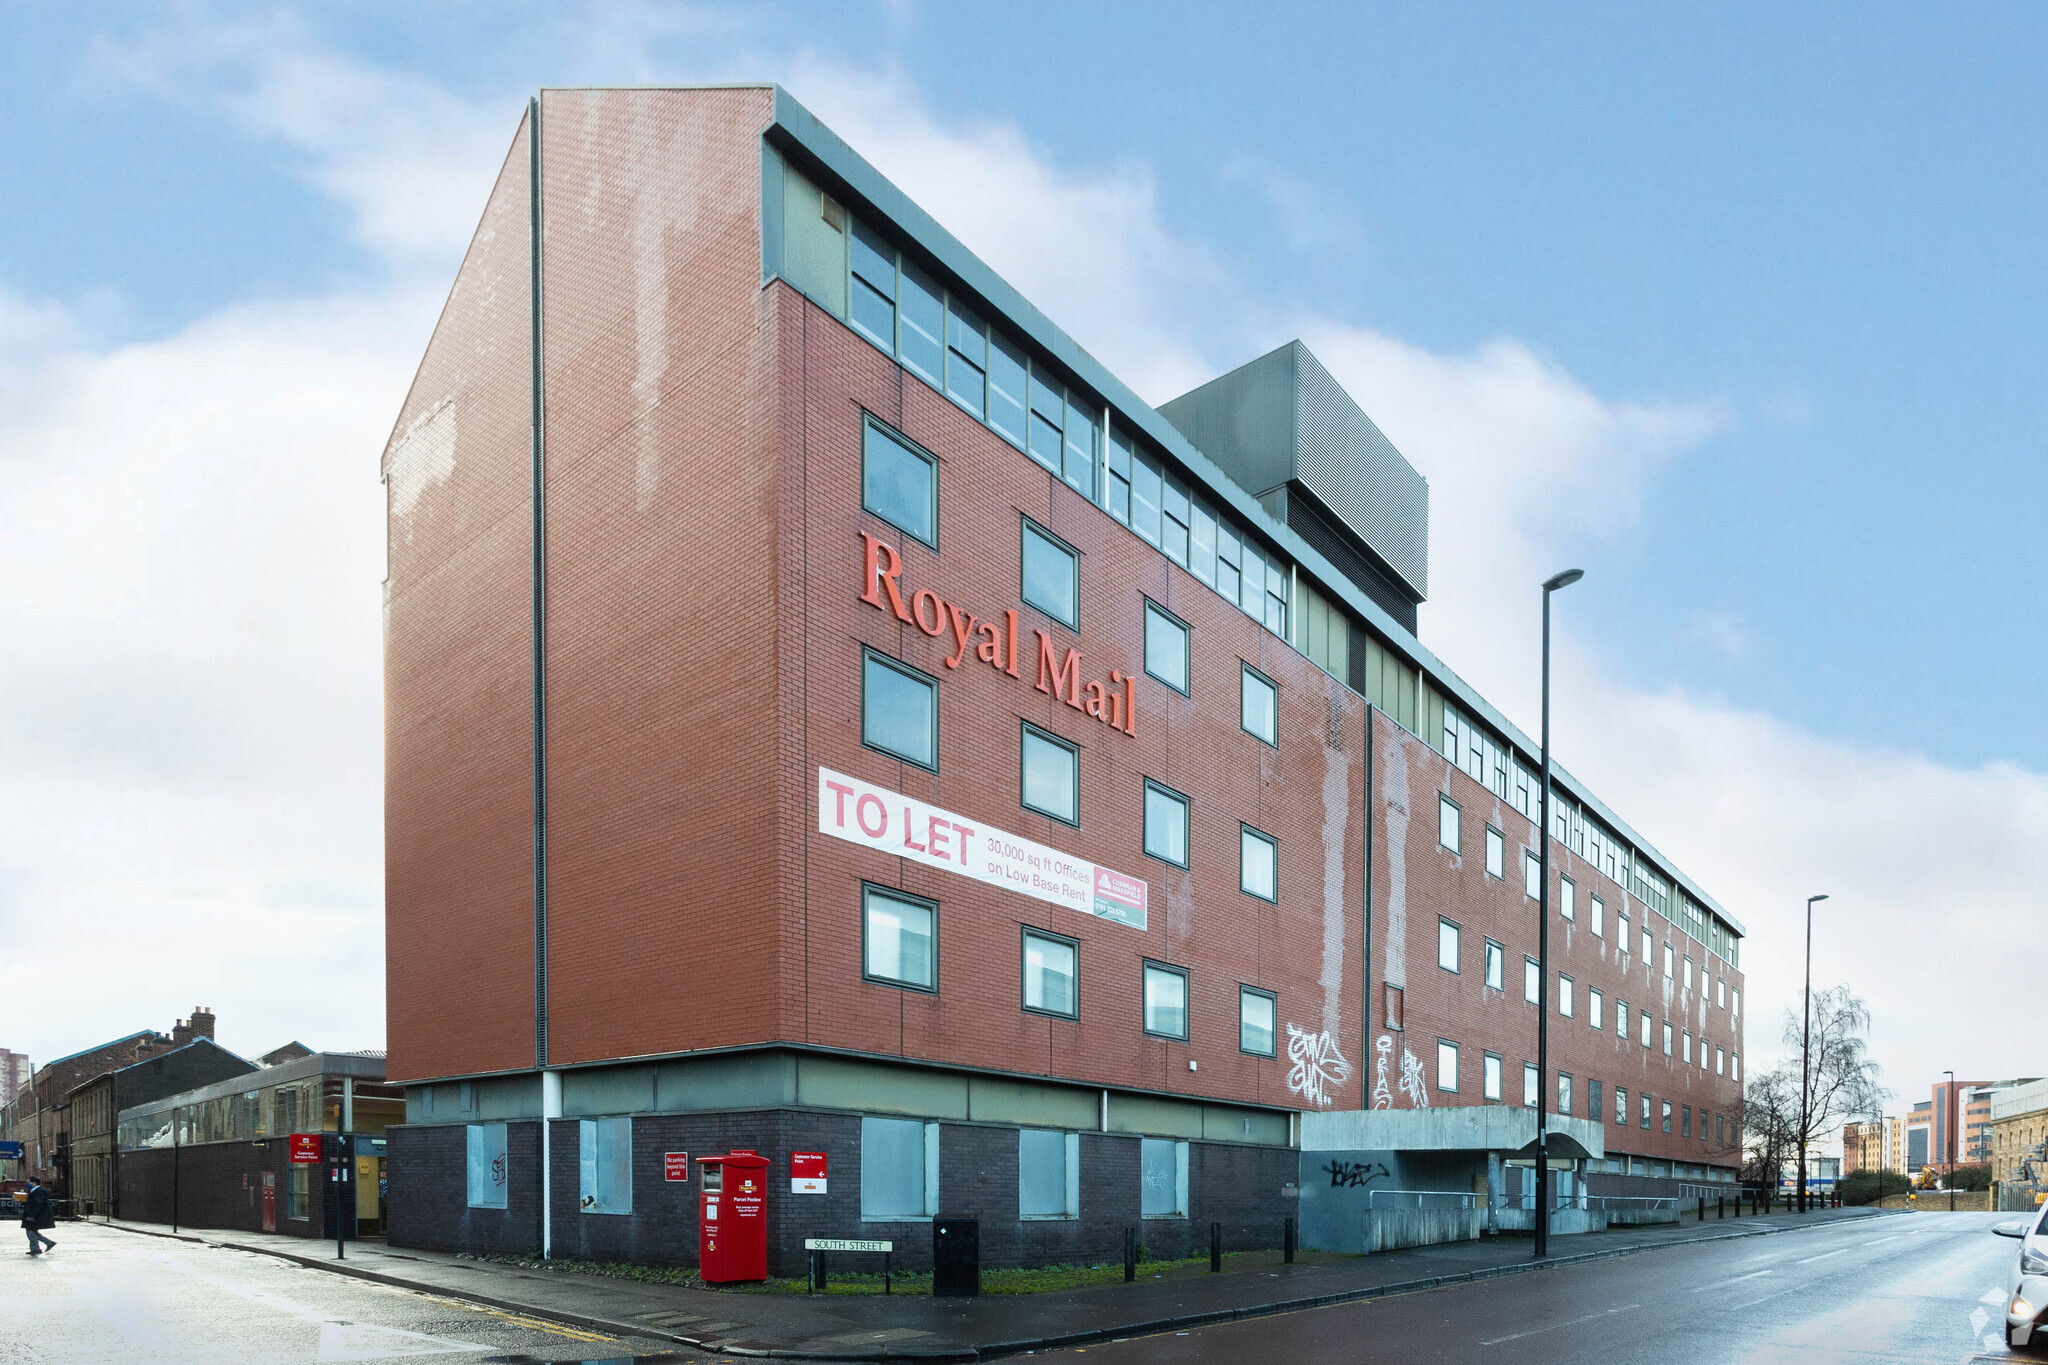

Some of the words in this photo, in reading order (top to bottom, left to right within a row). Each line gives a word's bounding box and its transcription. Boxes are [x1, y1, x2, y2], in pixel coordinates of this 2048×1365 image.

[858, 530, 1021, 680] Royal
[1035, 628, 1137, 739] Mail
[826, 779, 889, 840] TO
[903, 806, 975, 866] LET
[987, 837, 1025, 863] 30,000
[1027, 850, 1041, 869] sq
[1043, 853, 1051, 871] ft
[1054, 860, 1090, 885] Offices
[987, 862, 1003, 876] on
[1006, 864, 1030, 885] Low
[1033, 872, 1059, 894] Base
[1062, 882, 1086, 903] Rent
[1112, 878, 1137, 892] CUSHMAN
[1112, 885, 1141, 900] WAKEFIELD
[814, 1240, 846, 1250] SOUTH
[849, 1241, 884, 1251] STREET
